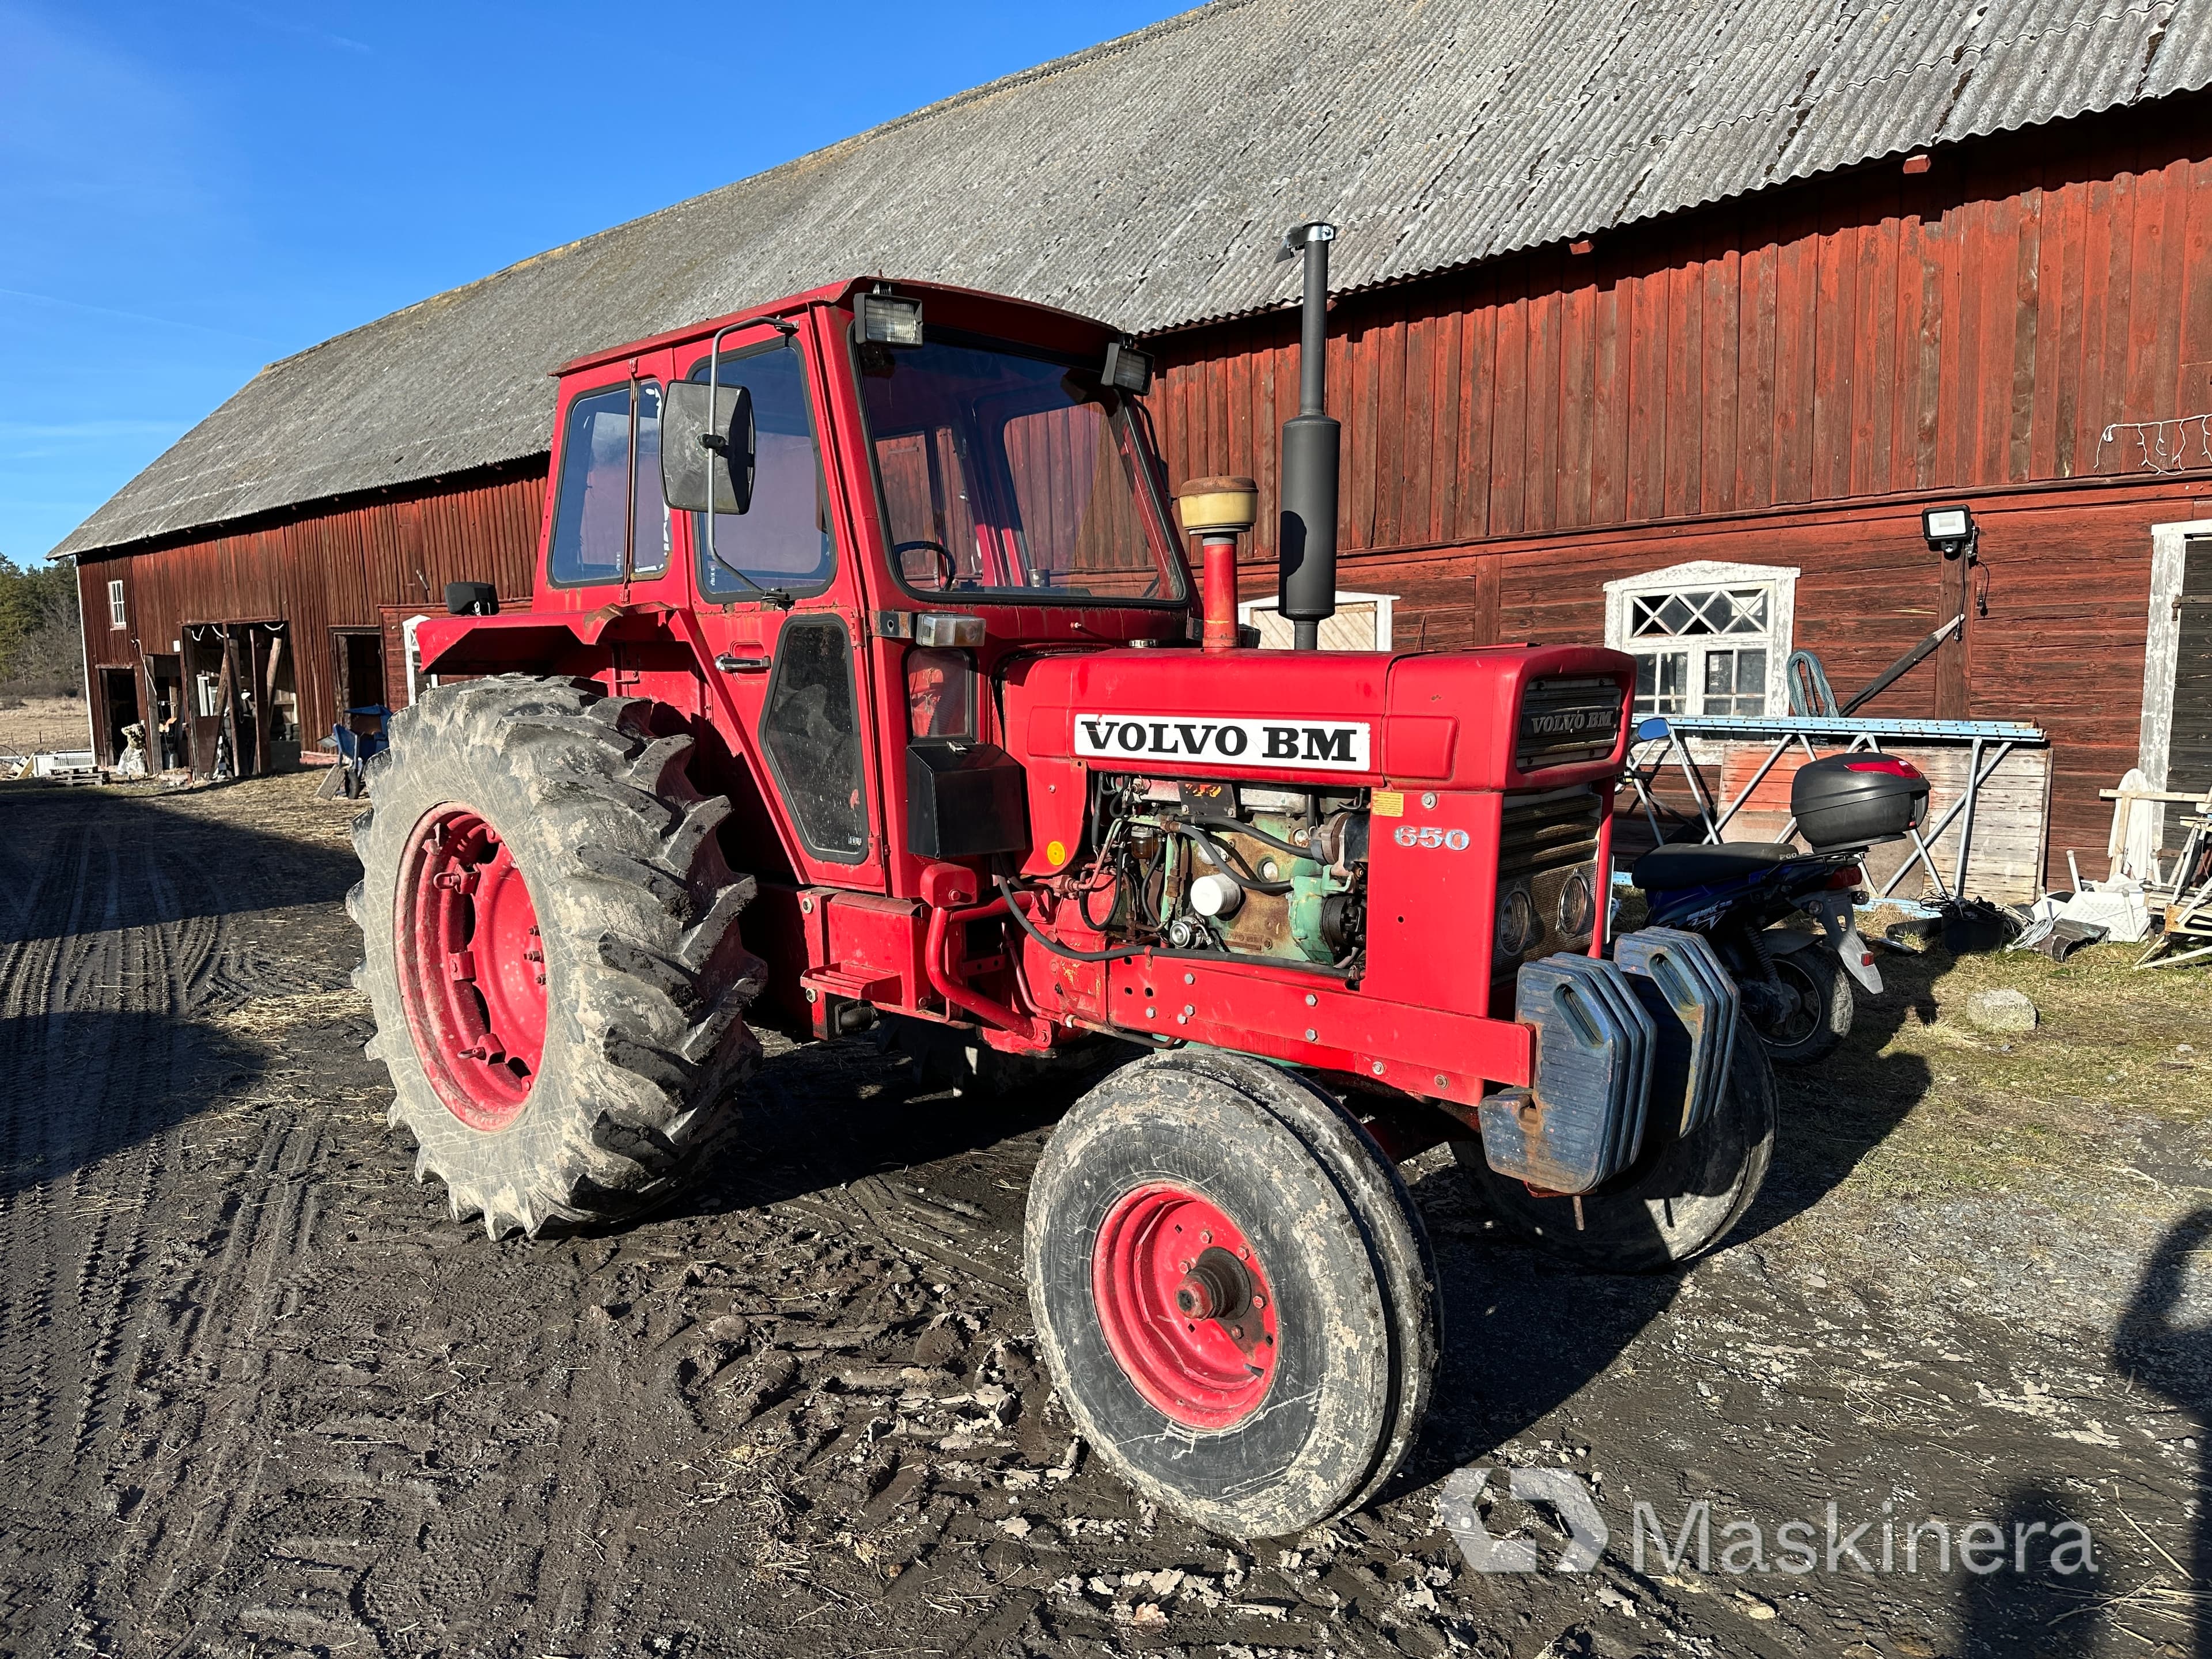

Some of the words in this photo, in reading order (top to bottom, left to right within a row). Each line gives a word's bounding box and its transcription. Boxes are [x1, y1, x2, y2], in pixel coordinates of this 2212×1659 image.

[1531, 713, 1585, 733] VOLVO
[1586, 711, 1613, 729] BM
[1081, 721, 1248, 756] VOLVO
[1262, 726, 1357, 762] BM
[1394, 825, 1470, 850] 650
[1779, 853, 1797, 861] PGO
